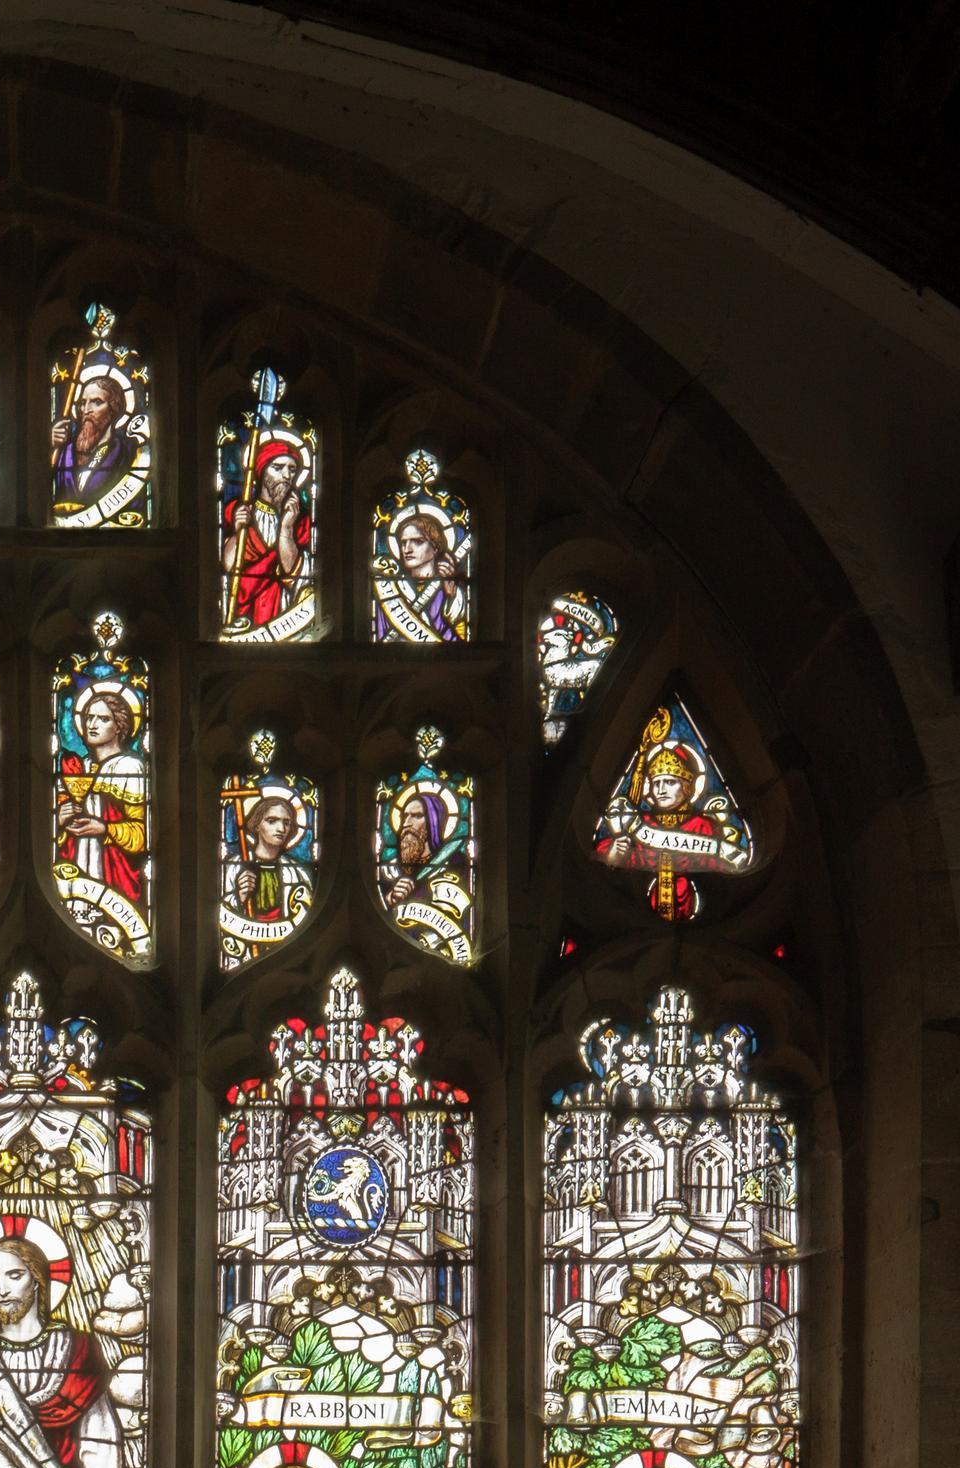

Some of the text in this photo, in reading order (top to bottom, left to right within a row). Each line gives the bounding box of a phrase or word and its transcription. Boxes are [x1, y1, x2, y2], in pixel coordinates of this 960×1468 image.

[104, 481, 136, 512] JUDE
[563, 605, 598, 626] AGNUS
[661, 836, 712, 852] ASAPH
[105, 897, 141, 932] JOHN
[240, 923, 287, 938] PHILIP
[290, 1402, 385, 1419] RABBONI
[613, 1397, 710, 1424] EMMAUS
